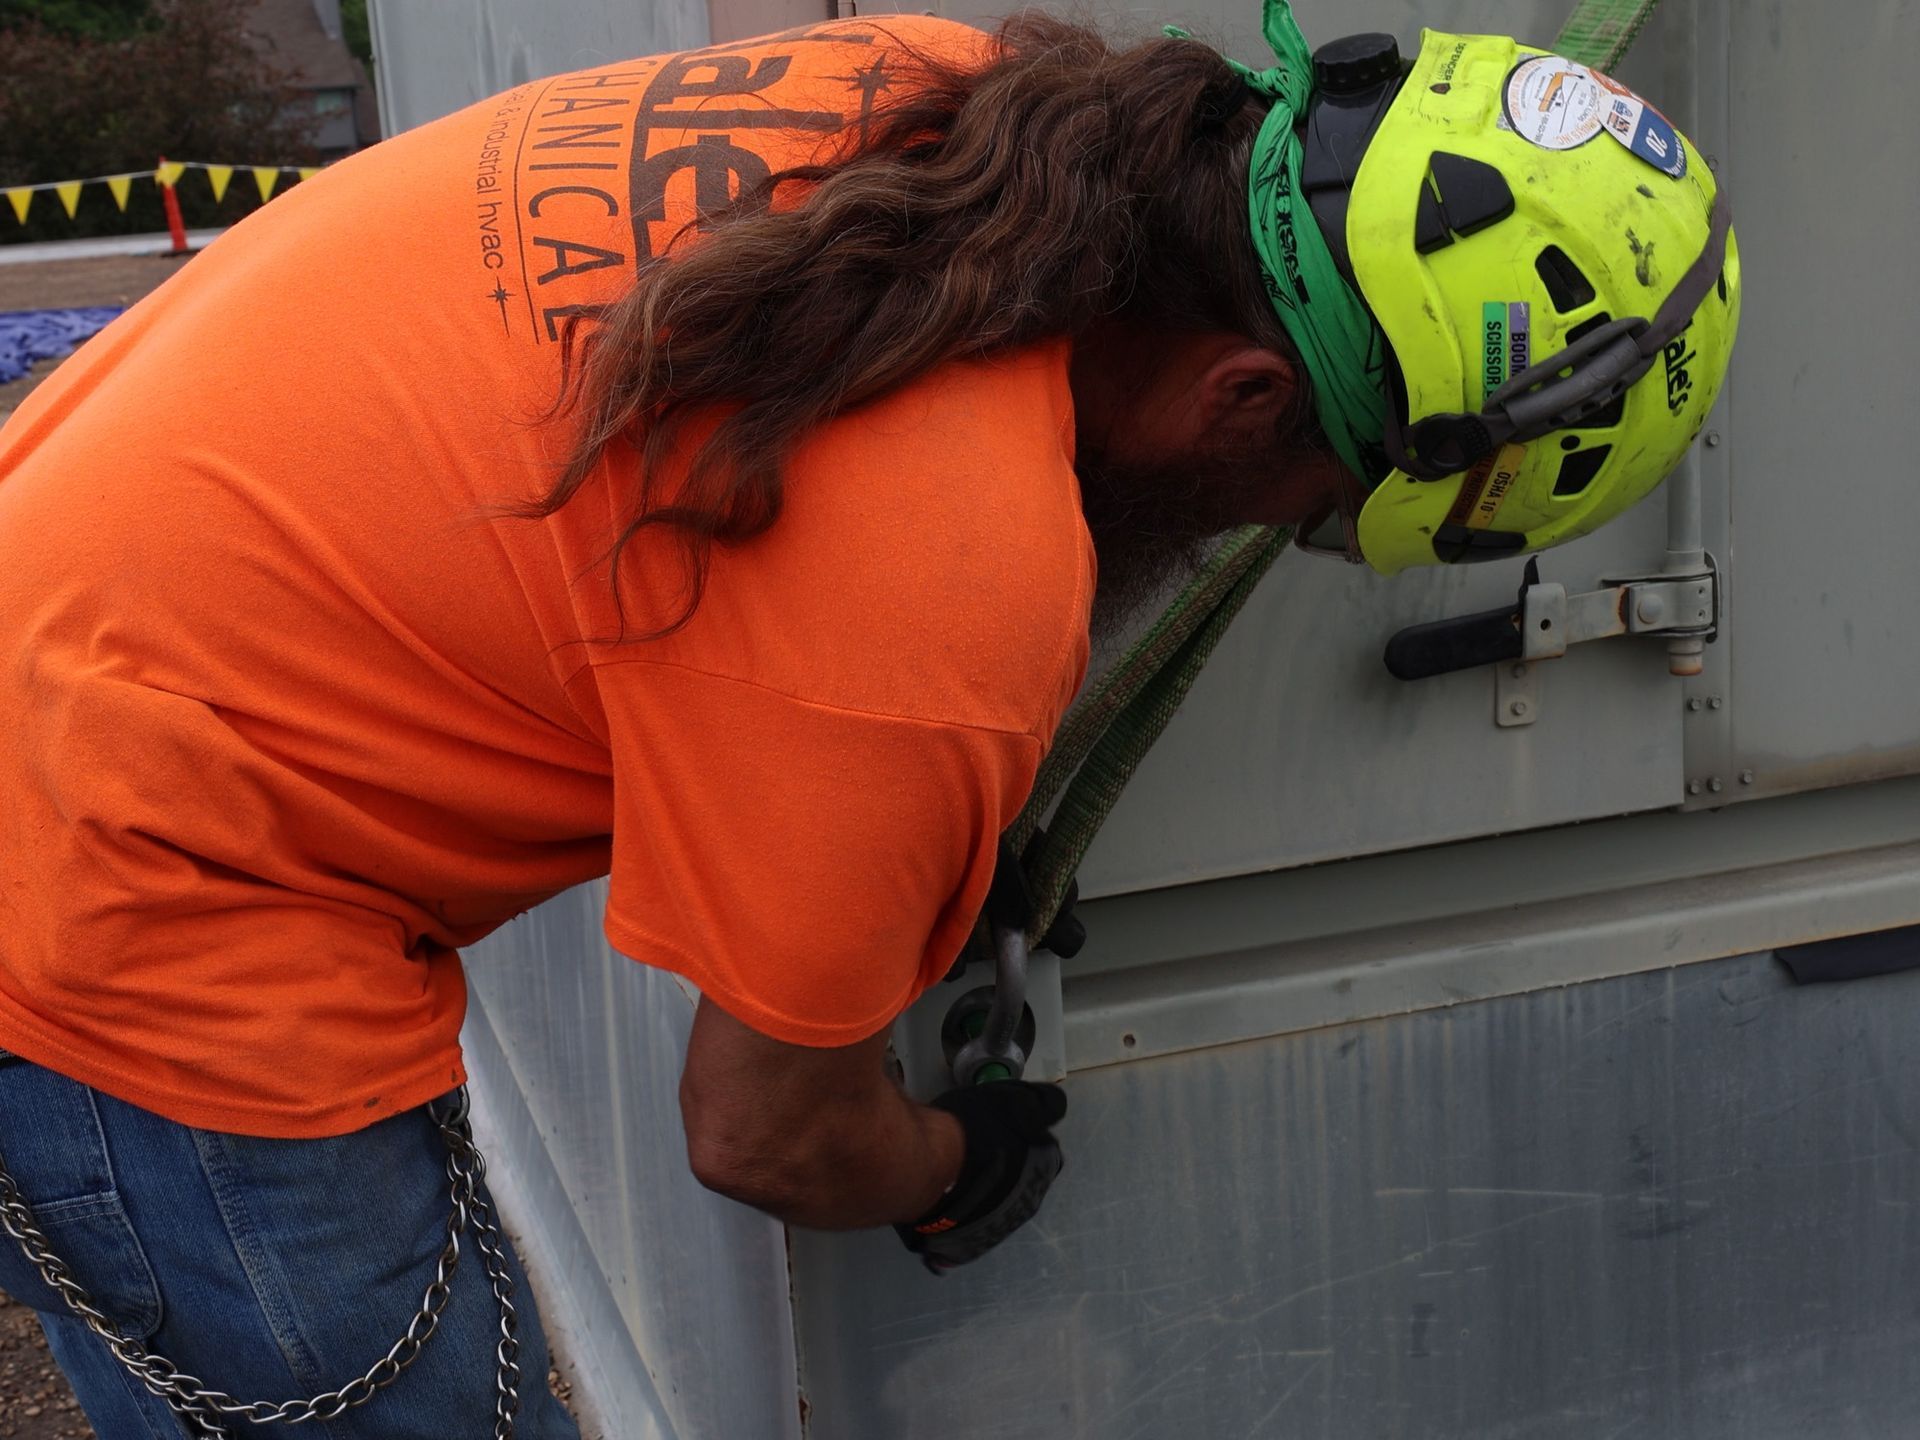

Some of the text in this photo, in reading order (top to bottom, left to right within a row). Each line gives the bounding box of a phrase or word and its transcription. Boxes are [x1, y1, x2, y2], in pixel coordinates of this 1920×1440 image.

[476, 117, 513, 194] industrial
[1645, 127, 1668, 157] 20
[477, 201, 504, 270] hvac
[1486, 321, 1502, 385] SCISSOR
[1480, 471, 1512, 513] OSHA 10
